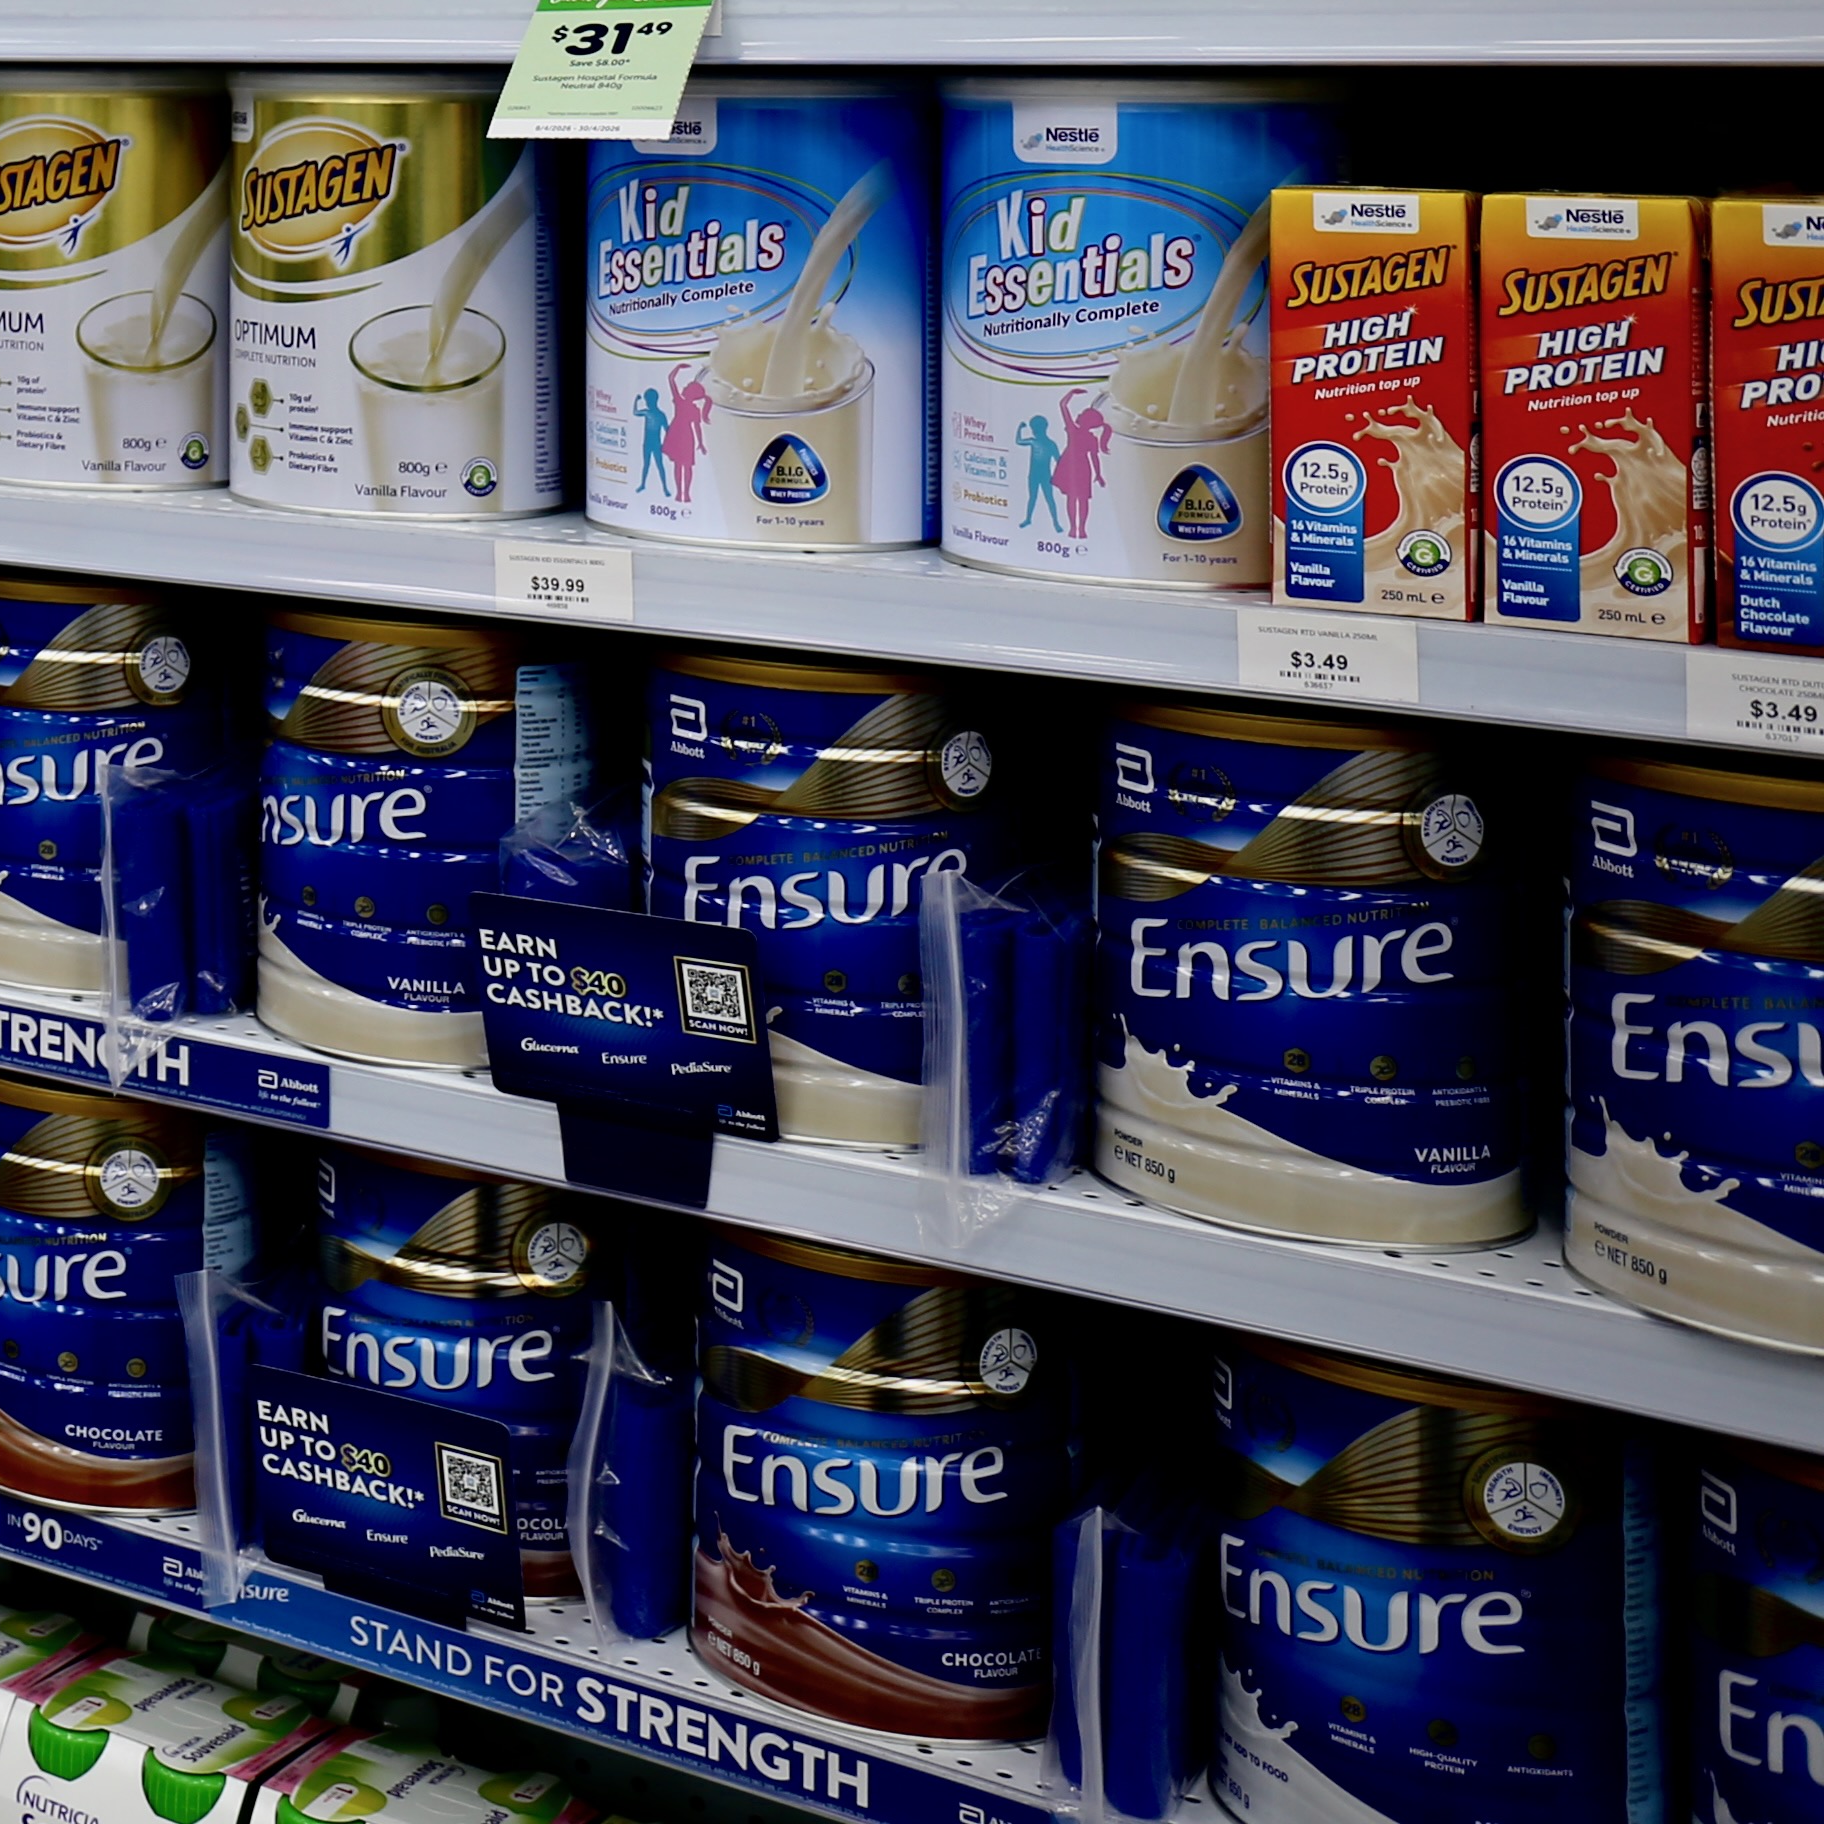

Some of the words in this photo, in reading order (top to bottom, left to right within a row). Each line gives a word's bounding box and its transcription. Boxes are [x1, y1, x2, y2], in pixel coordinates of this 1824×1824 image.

[995, 188, 1085, 263] Kid
[966, 231, 1195, 321] Essentials
[983, 312, 1071, 338] Nutritionally
[1075, 298, 1160, 324] Complete
[1322, 310, 1412, 350] HIGH
[1292, 336, 1444, 384] PROTEIN
[1314, 380, 1373, 401] Nutrition
[1377, 378, 1398, 394] top
[1401, 376, 1420, 392] up
[122, 435, 152, 453] 800g
[81, 458, 120, 473] Vanilla
[123, 458, 167, 473] Flavour
[1299, 461, 1349, 483] 12.5g
[963, 490, 1009, 508] Probiotics
[1291, 520, 1303, 532] 16
[1305, 520, 1358, 535] Vitamins
[1037, 539, 1070, 558] 800g
[1290, 562, 1331, 576] Vanilla
[530, 576, 585, 593] $39.99
[1381, 589, 1404, 604] 250
[1407, 590, 1427, 604] mL
[1739, 594, 1780, 610] Dutch
[1740, 608, 1810, 625] Chocolate
[1258, 627, 1298, 635] SUSTAGEN
[1290, 651, 1349, 671] $3.49
[1115, 792, 1153, 814] Abbott
[478, 927, 558, 960] EARN
[1130, 916, 1456, 1003] Ensure
[482, 955, 520, 980] UP
[525, 962, 566, 987] TO
[570, 967, 627, 1000] $40
[1124, 1150, 1142, 1170] NET
[1145, 1157, 1166, 1178] 850
[1414, 1145, 1492, 1164] VANILLA
[722, 1423, 1008, 1518] Ensure
[7, 1512, 21, 1528] IN
[22, 1511, 62, 1550] 90
[1219, 1533, 1526, 1656] Ensure
[1507, 1765, 1574, 1777] ANTIOXIDANTS
